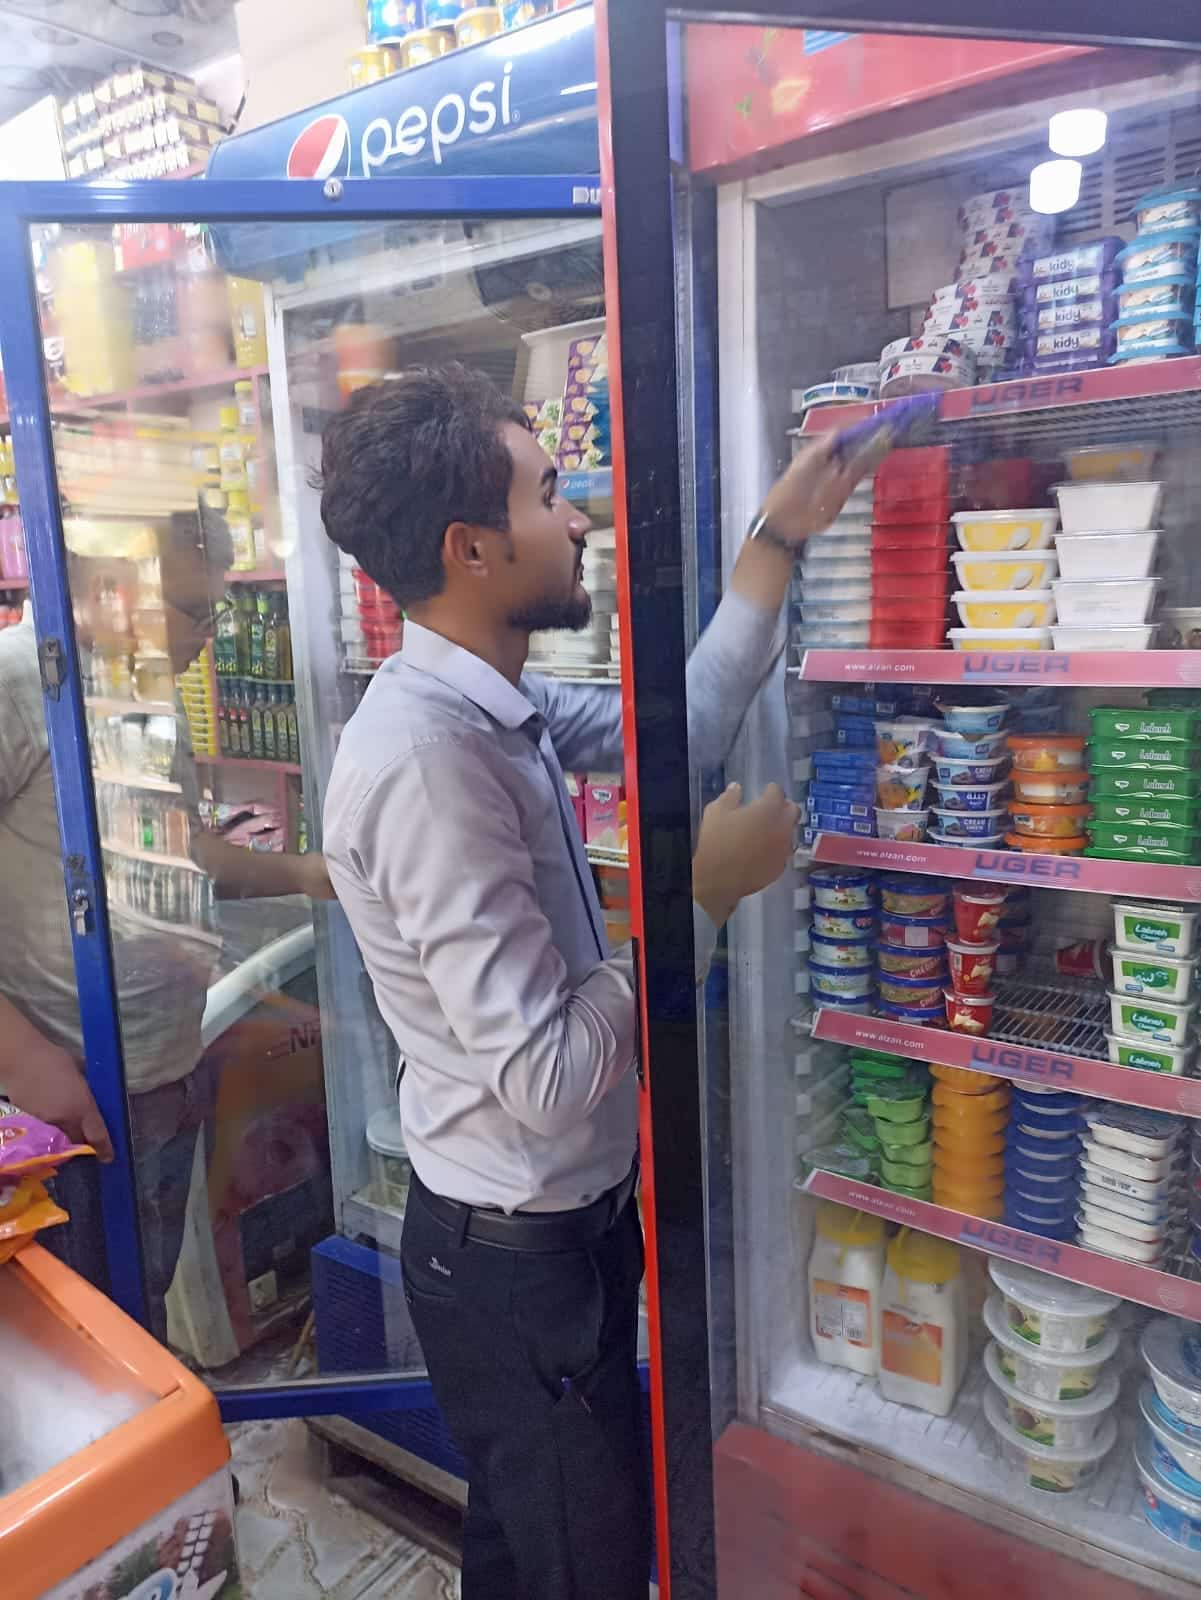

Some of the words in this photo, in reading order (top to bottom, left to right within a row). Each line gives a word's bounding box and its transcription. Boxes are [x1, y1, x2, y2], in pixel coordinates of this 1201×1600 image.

[361, 61, 513, 178] pepsi
[1053, 284, 1079, 298] kidy
[1055, 309, 1081, 322] kidy
[1053, 335, 1079, 349] kidy
[855, 1029, 925, 1050] www.alzan.com
